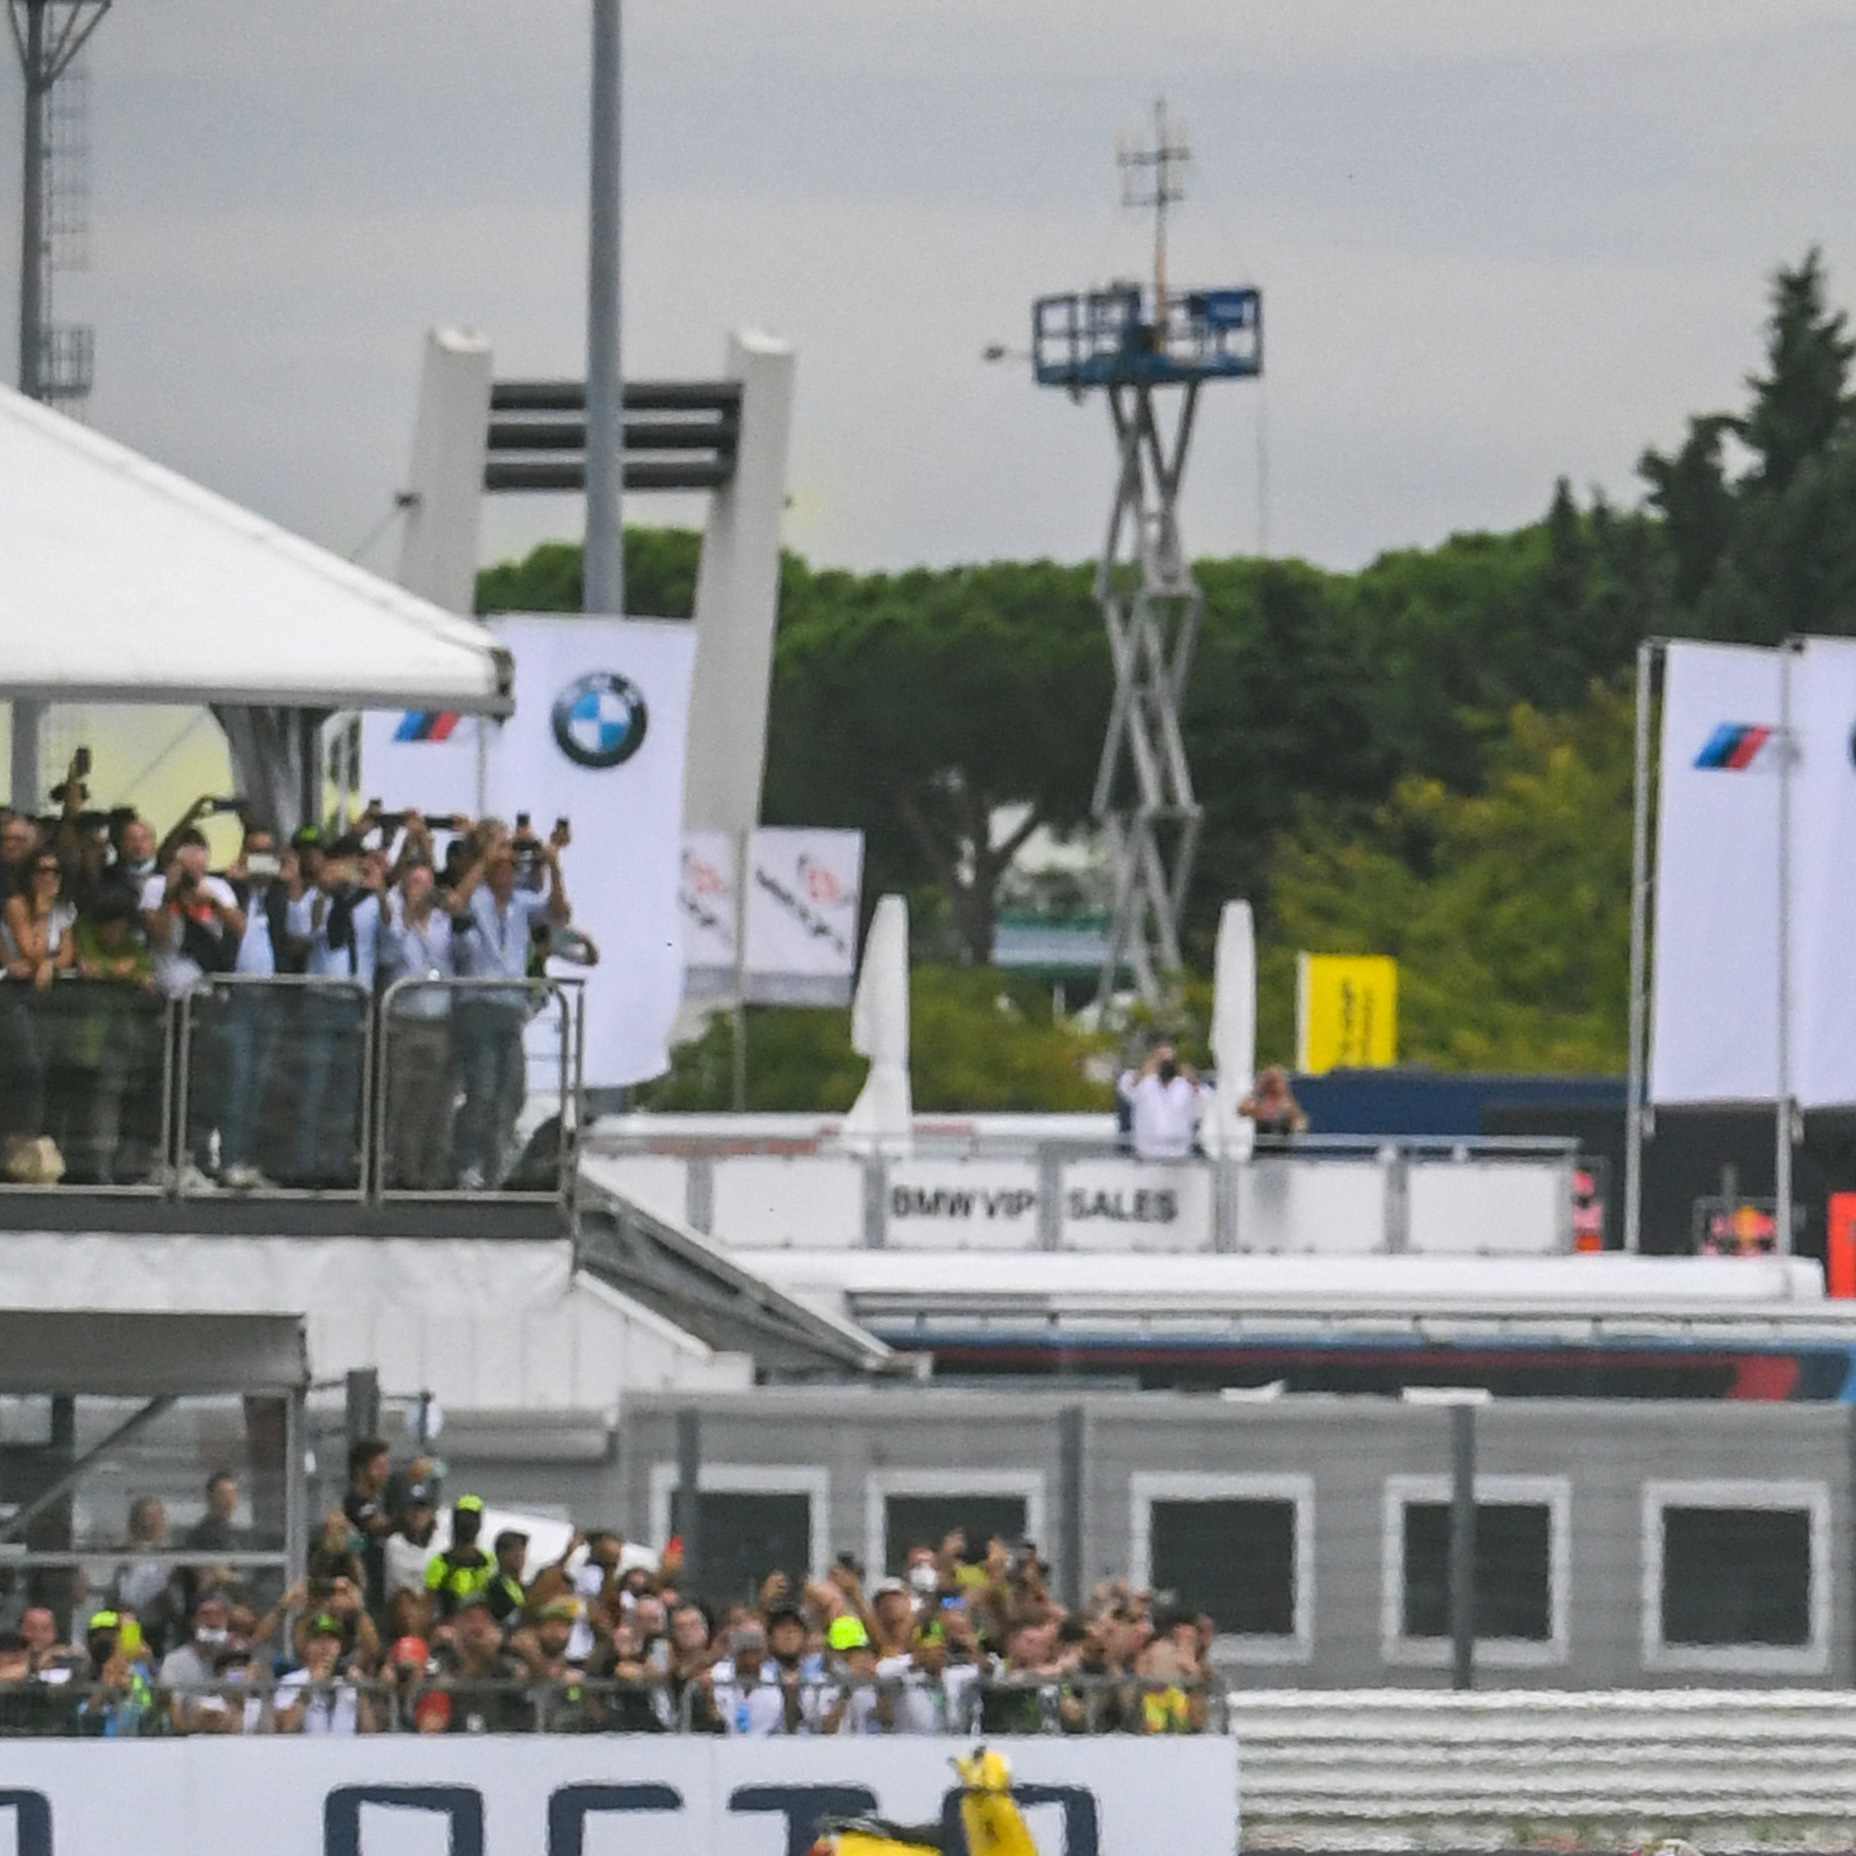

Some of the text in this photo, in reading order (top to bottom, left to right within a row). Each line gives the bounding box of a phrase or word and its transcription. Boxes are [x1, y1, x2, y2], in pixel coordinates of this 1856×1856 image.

[893, 1184, 1178, 1222] BMW VIP SALES
